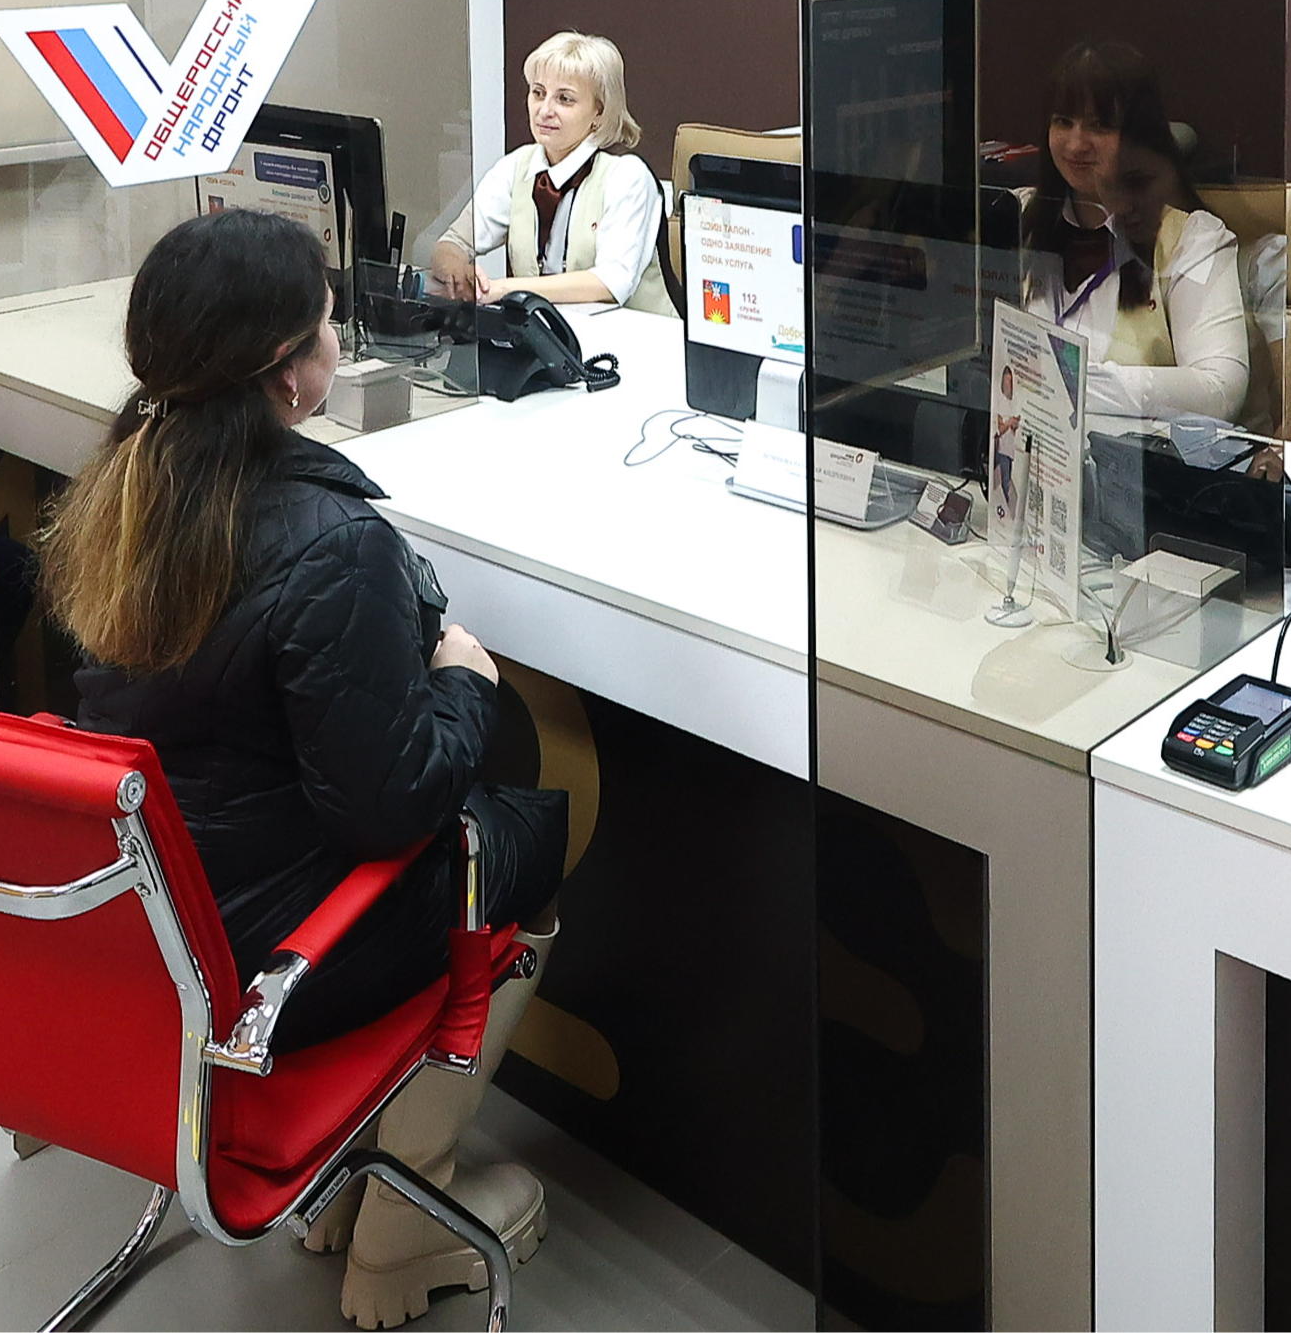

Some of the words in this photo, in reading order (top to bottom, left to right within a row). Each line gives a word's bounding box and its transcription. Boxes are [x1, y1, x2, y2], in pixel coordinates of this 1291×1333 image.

[172, 13, 258, 157] НАРОДНЫЙ
[201, 62, 253, 153] ФРОНТ
[701, 254, 723, 264] ОДНА
[725, 259, 754, 270] УСЛУГА
[742, 293, 757, 304] 112
